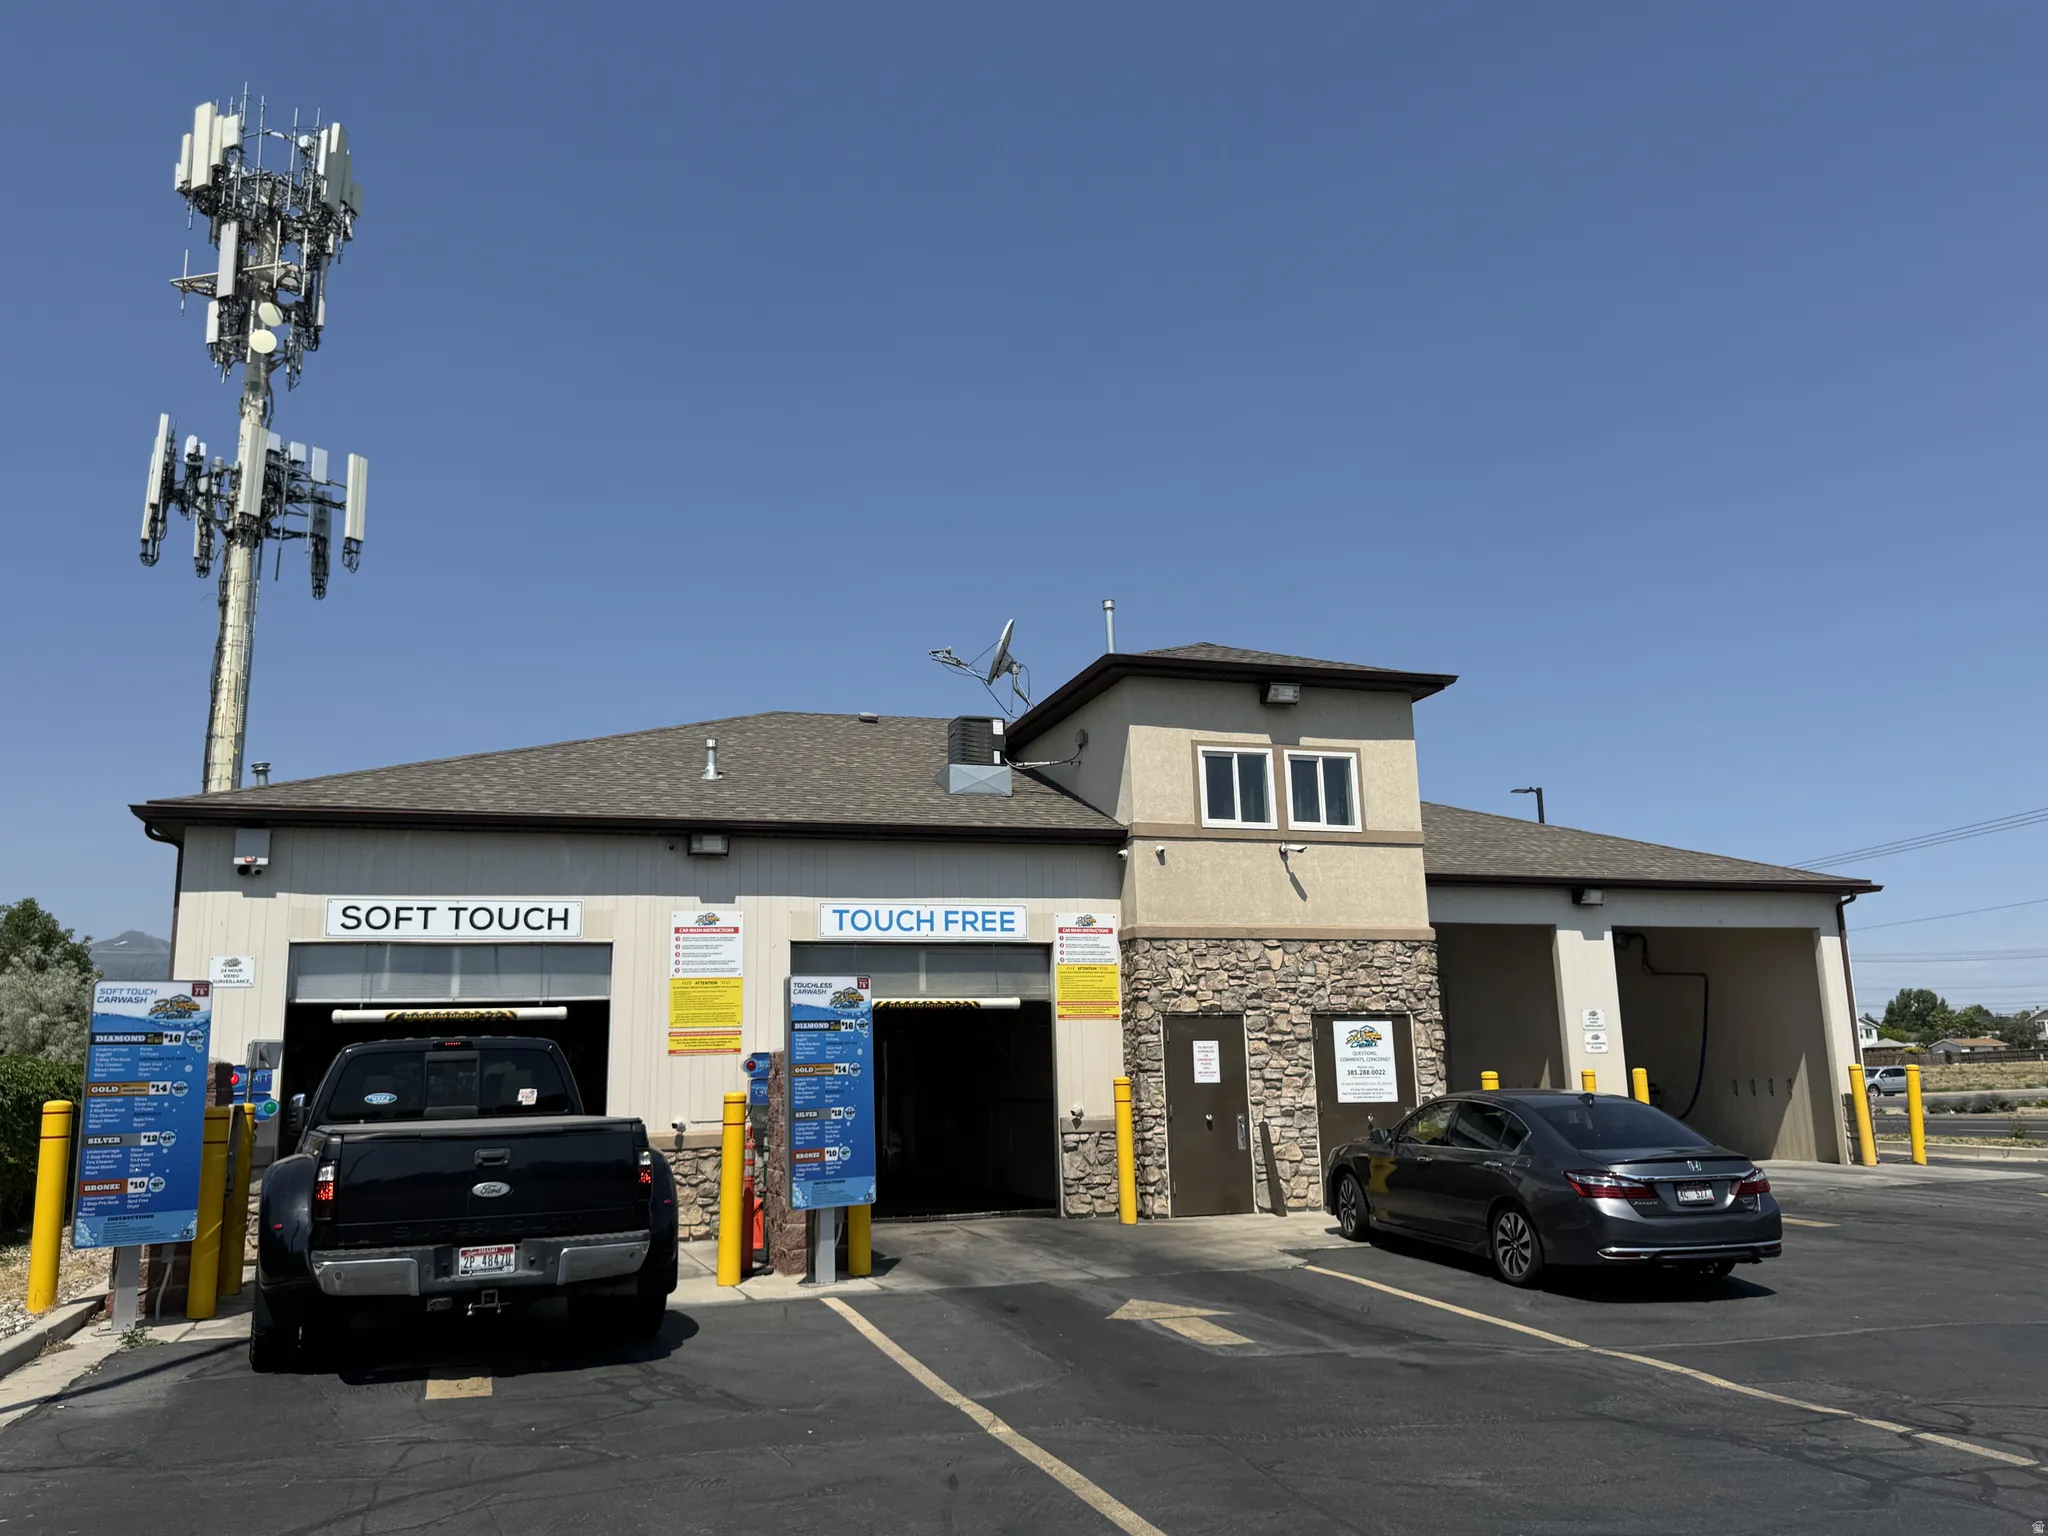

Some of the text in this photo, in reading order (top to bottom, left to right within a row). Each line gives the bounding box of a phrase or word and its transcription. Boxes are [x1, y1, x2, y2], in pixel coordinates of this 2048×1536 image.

[340, 905, 569, 931] SOFT TOUCH
[832, 909, 1015, 932] TOUCH FREE
[842, 1021, 853, 1029] $16
[164, 1033, 181, 1043] $16
[835, 1065, 847, 1073] $14
[151, 1084, 167, 1092] $14
[143, 1135, 158, 1143] $12
[130, 1181, 145, 1189] $10
[480, 1185, 502, 1194] Ford
[464, 1253, 511, 1268] 2P 4847U
